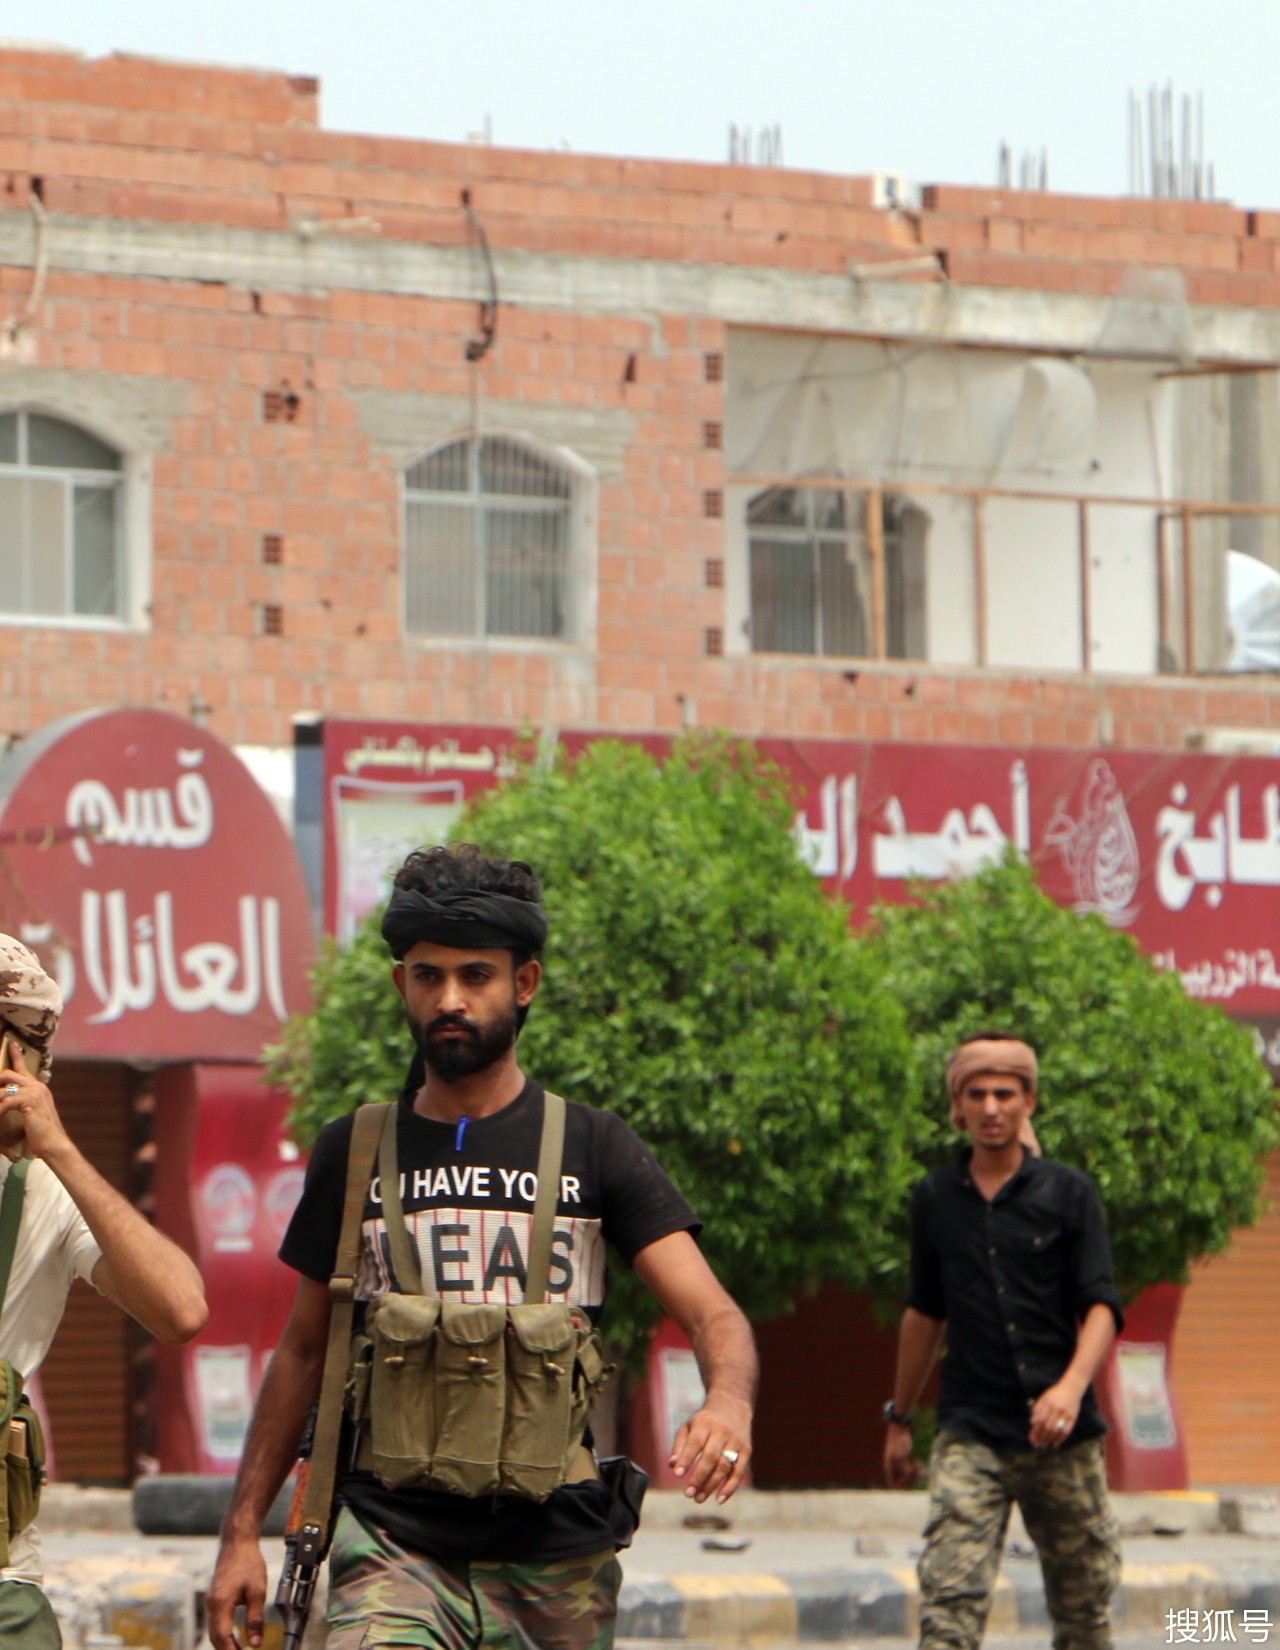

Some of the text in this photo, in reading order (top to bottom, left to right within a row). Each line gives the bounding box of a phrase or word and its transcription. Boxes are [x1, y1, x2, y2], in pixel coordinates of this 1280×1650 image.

[65, 746, 214, 867] قسم
[413, 1165, 491, 1199] HAVE
[498, 1167, 581, 1204] YOR
